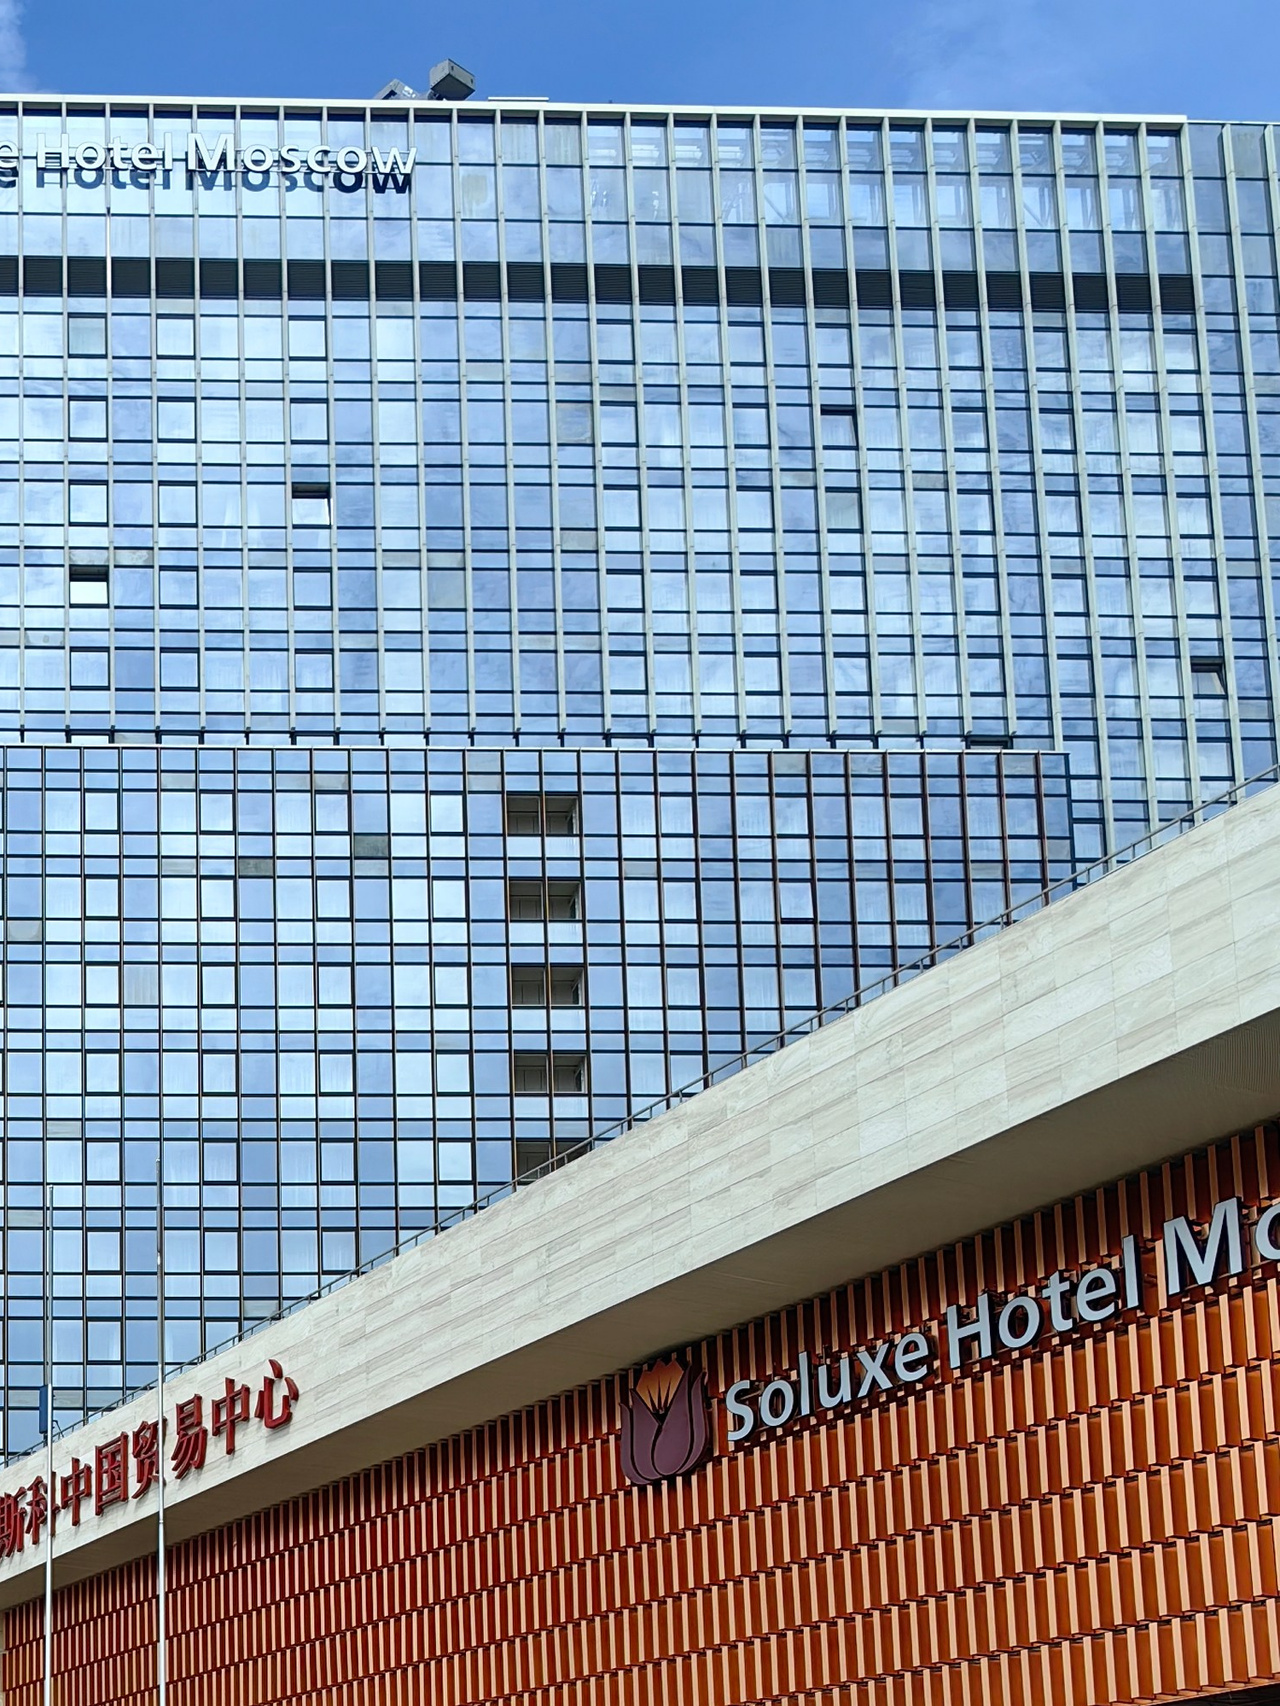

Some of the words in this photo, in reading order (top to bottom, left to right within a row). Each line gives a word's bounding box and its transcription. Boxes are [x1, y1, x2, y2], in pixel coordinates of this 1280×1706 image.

[35, 132, 173, 171] Hotel
[187, 132, 417, 174] Moscow
[725, 1332, 930, 1441] Soluxe
[946, 1234, 1140, 1369] Hotel
